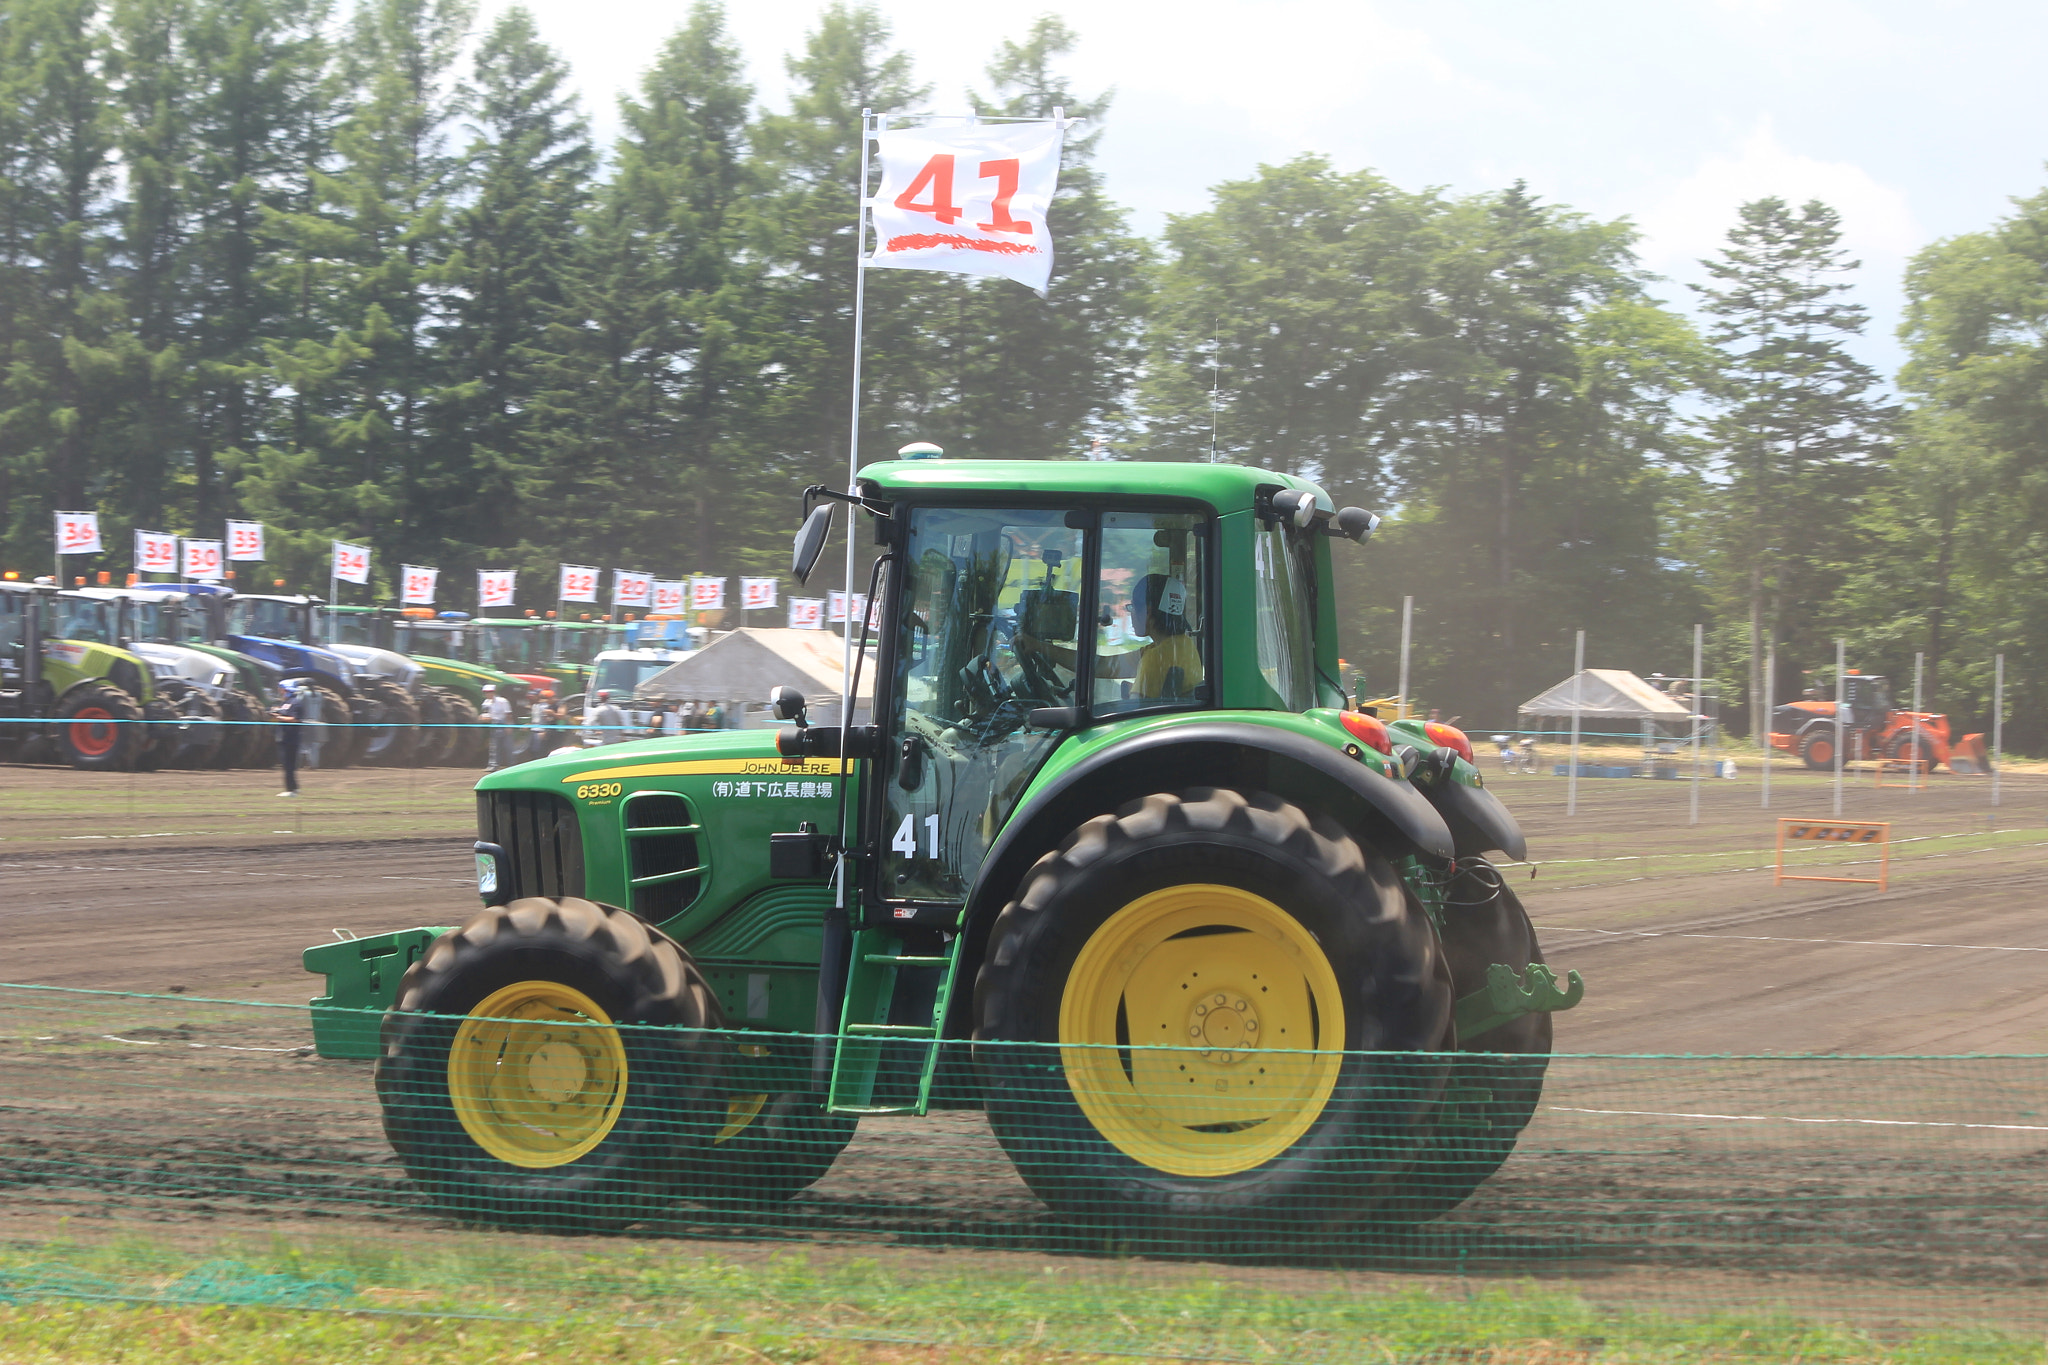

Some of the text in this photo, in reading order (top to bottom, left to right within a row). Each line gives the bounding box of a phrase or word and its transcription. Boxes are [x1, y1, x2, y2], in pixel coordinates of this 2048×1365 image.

[893, 153, 1034, 235] 41
[63, 522, 96, 541] 36
[233, 530, 262, 549] 35
[144, 541, 174, 561] 32
[187, 548, 220, 567] 30
[338, 551, 366, 568] 34
[482, 579, 512, 596] 24
[564, 574, 595, 591] 22
[618, 578, 649, 596] 20
[740, 761, 831, 774] JOHN DEERE
[577, 782, 622, 799] 6330
[892, 813, 939, 859] 41
